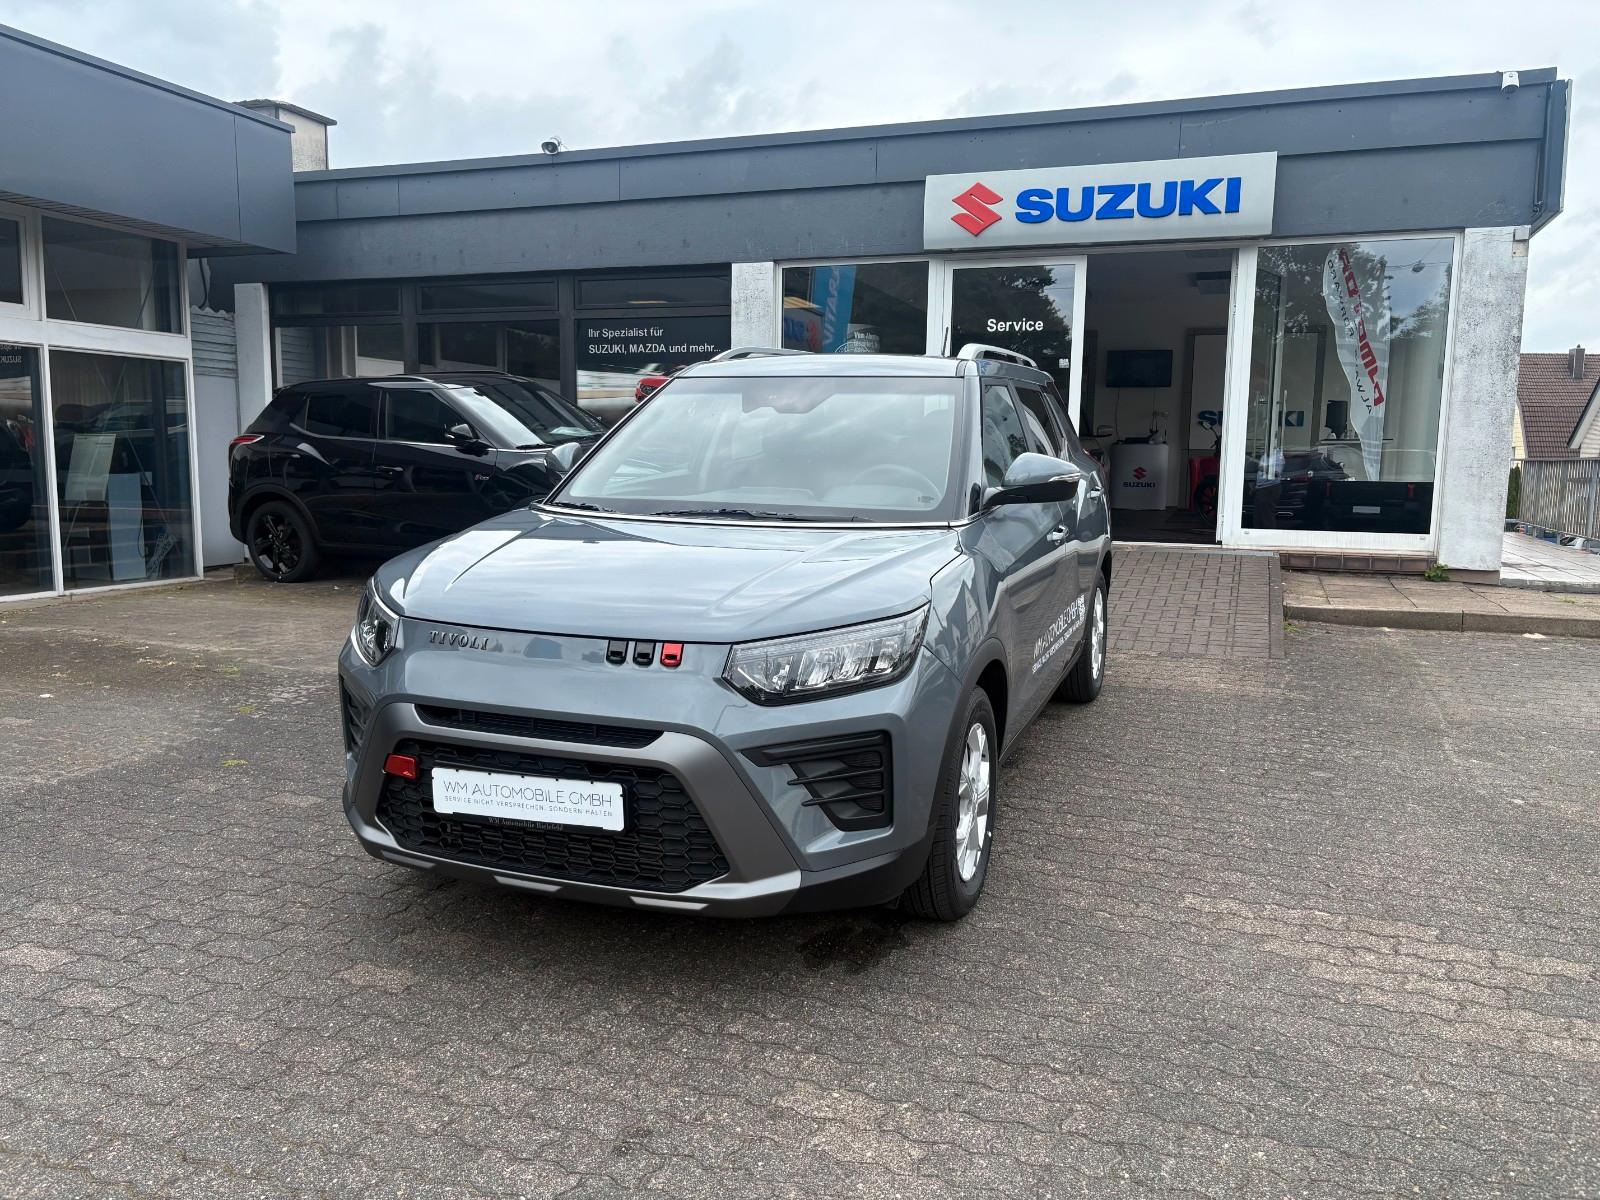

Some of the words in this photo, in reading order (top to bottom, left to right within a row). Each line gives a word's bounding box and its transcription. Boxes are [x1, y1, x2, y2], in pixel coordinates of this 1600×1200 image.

[1015, 177, 1241, 224] SUZUKI
[588, 328, 600, 338] Ihr
[602, 327, 648, 339] Spezialist
[650, 326, 664, 337] für
[986, 318, 1044, 332] Service
[588, 344, 627, 355] SUZUKI,
[629, 343, 666, 353] MAZDA
[669, 343, 687, 353] und
[689, 343, 721, 353] mehr...
[428, 630, 489, 650] TIVOLI
[443, 781, 468, 794] WM
[472, 783, 566, 804] AUTOMOBILE
[569, 791, 612, 808] GMBH
[444, 795, 472, 804] SERVICE
[548, 806, 583, 814] SONDERN
[585, 809, 613, 817] HALTEN
